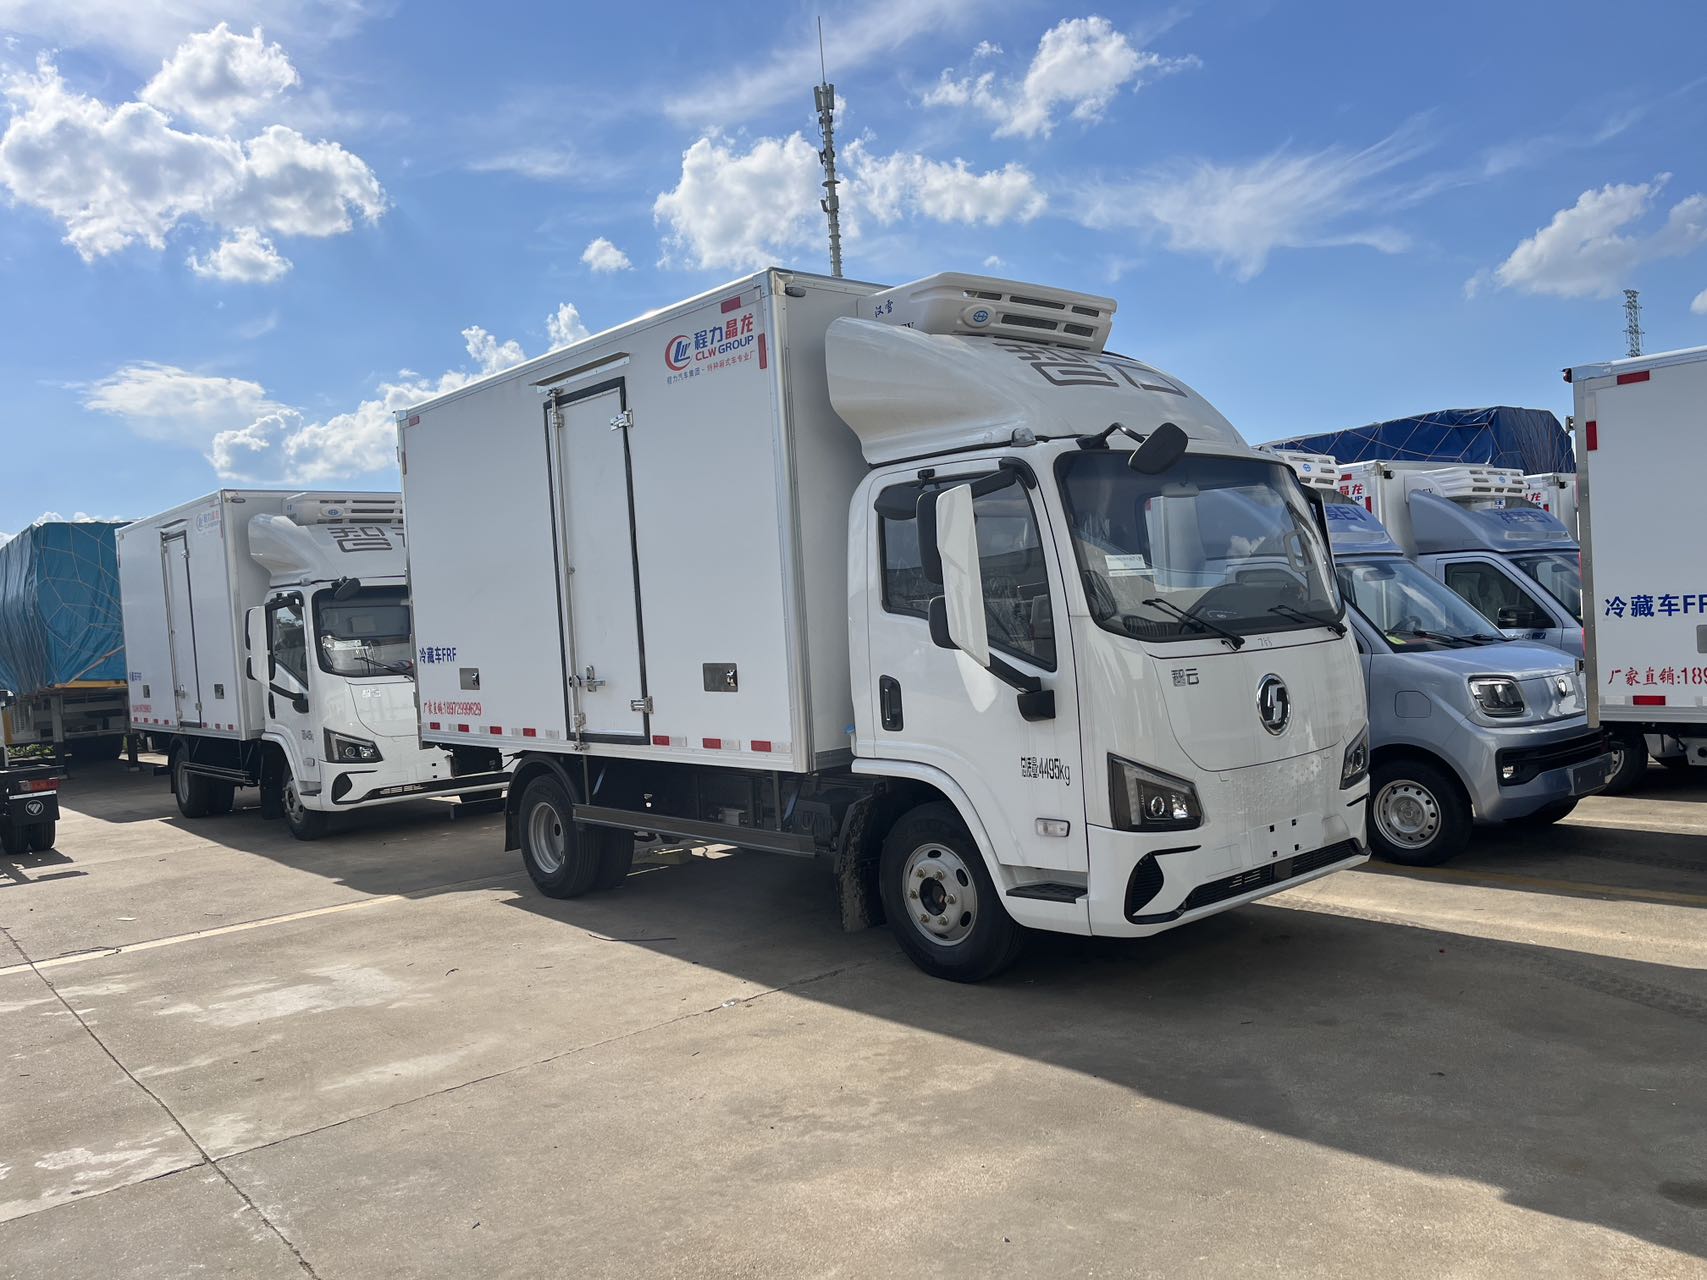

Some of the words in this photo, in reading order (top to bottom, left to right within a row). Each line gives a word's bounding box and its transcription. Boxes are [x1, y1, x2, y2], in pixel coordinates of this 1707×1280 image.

[694, 313, 754, 351] 程力晶龙
[695, 346, 717, 362] CLW
[718, 335, 754, 355] GROUP
[419, 646, 457, 664] 冷藏车FRF
